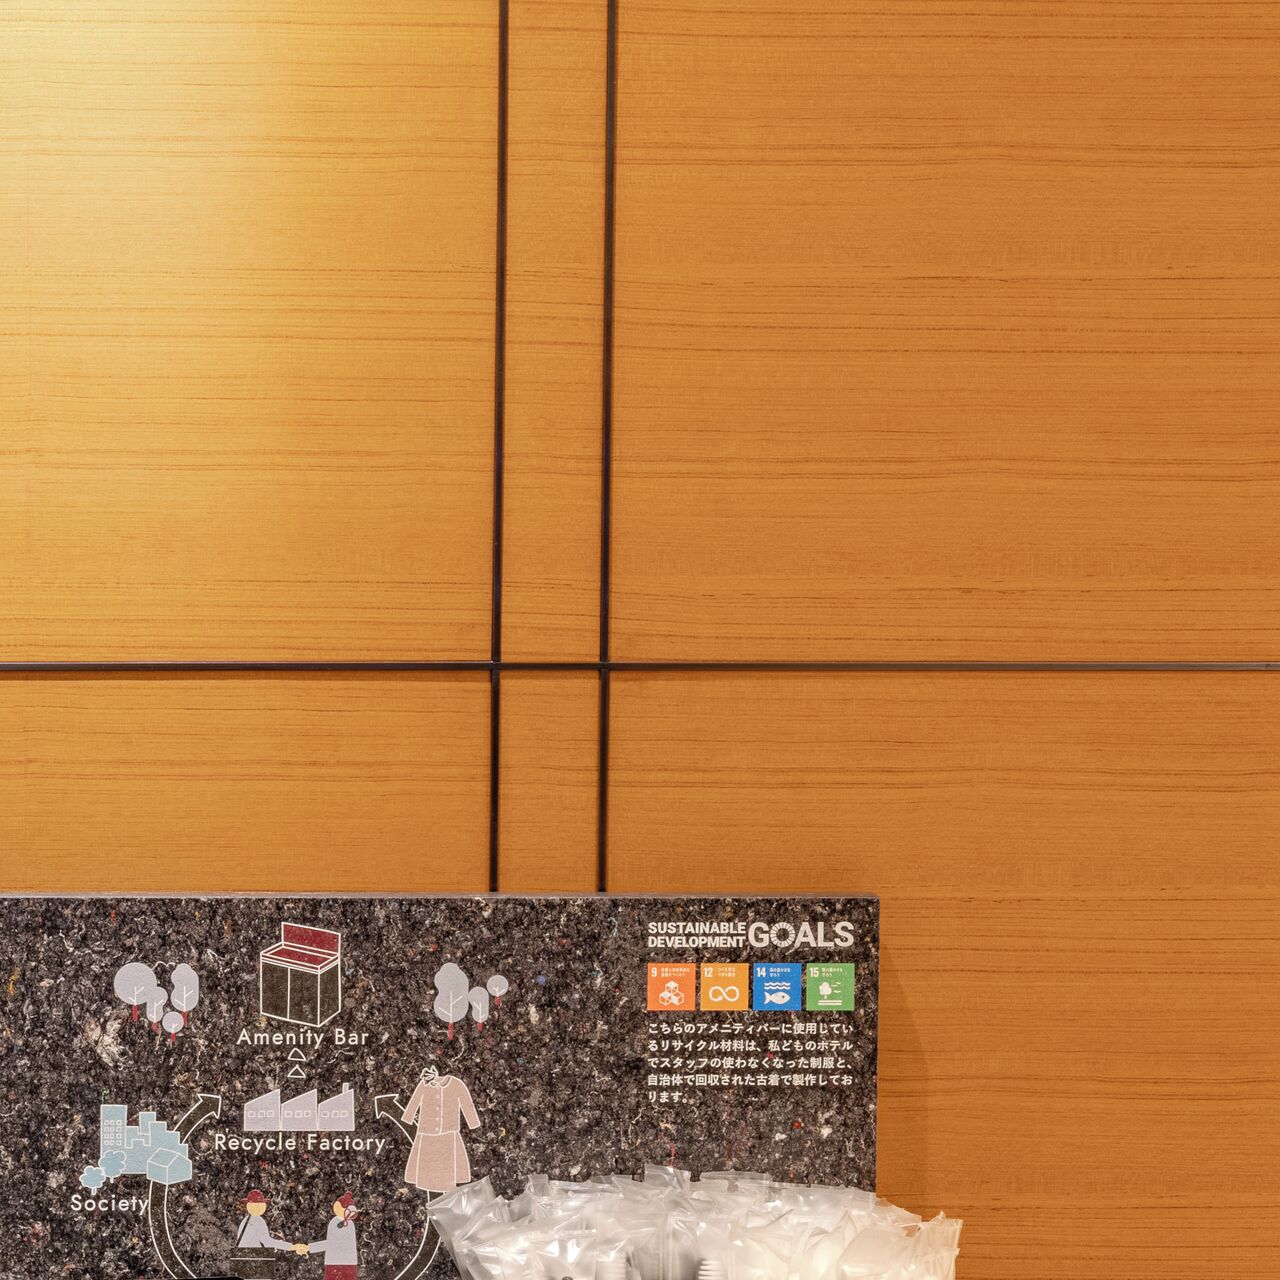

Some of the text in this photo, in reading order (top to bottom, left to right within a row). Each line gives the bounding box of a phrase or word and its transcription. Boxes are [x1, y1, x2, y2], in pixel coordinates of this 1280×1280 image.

[648, 922, 746, 934] SUSTAINABLE
[748, 922, 854, 948] GOALS
[648, 936, 745, 948] DEVELOPMENT
[650, 967, 658, 978] 9
[704, 967, 713, 978] 12
[756, 967, 766, 978] 14
[809, 967, 819, 978] 15
[237, 1029, 369, 1049] Amenity Bar
[648, 1040, 853, 1052] るリサイクル材料は、私どものホテル
[648, 1074, 853, 1086] 自治体で回収された古着で製作してお
[648, 1091, 688, 1103] ります。
[215, 1132, 386, 1155] Recycle Factory
[71, 1194, 149, 1215] Society
